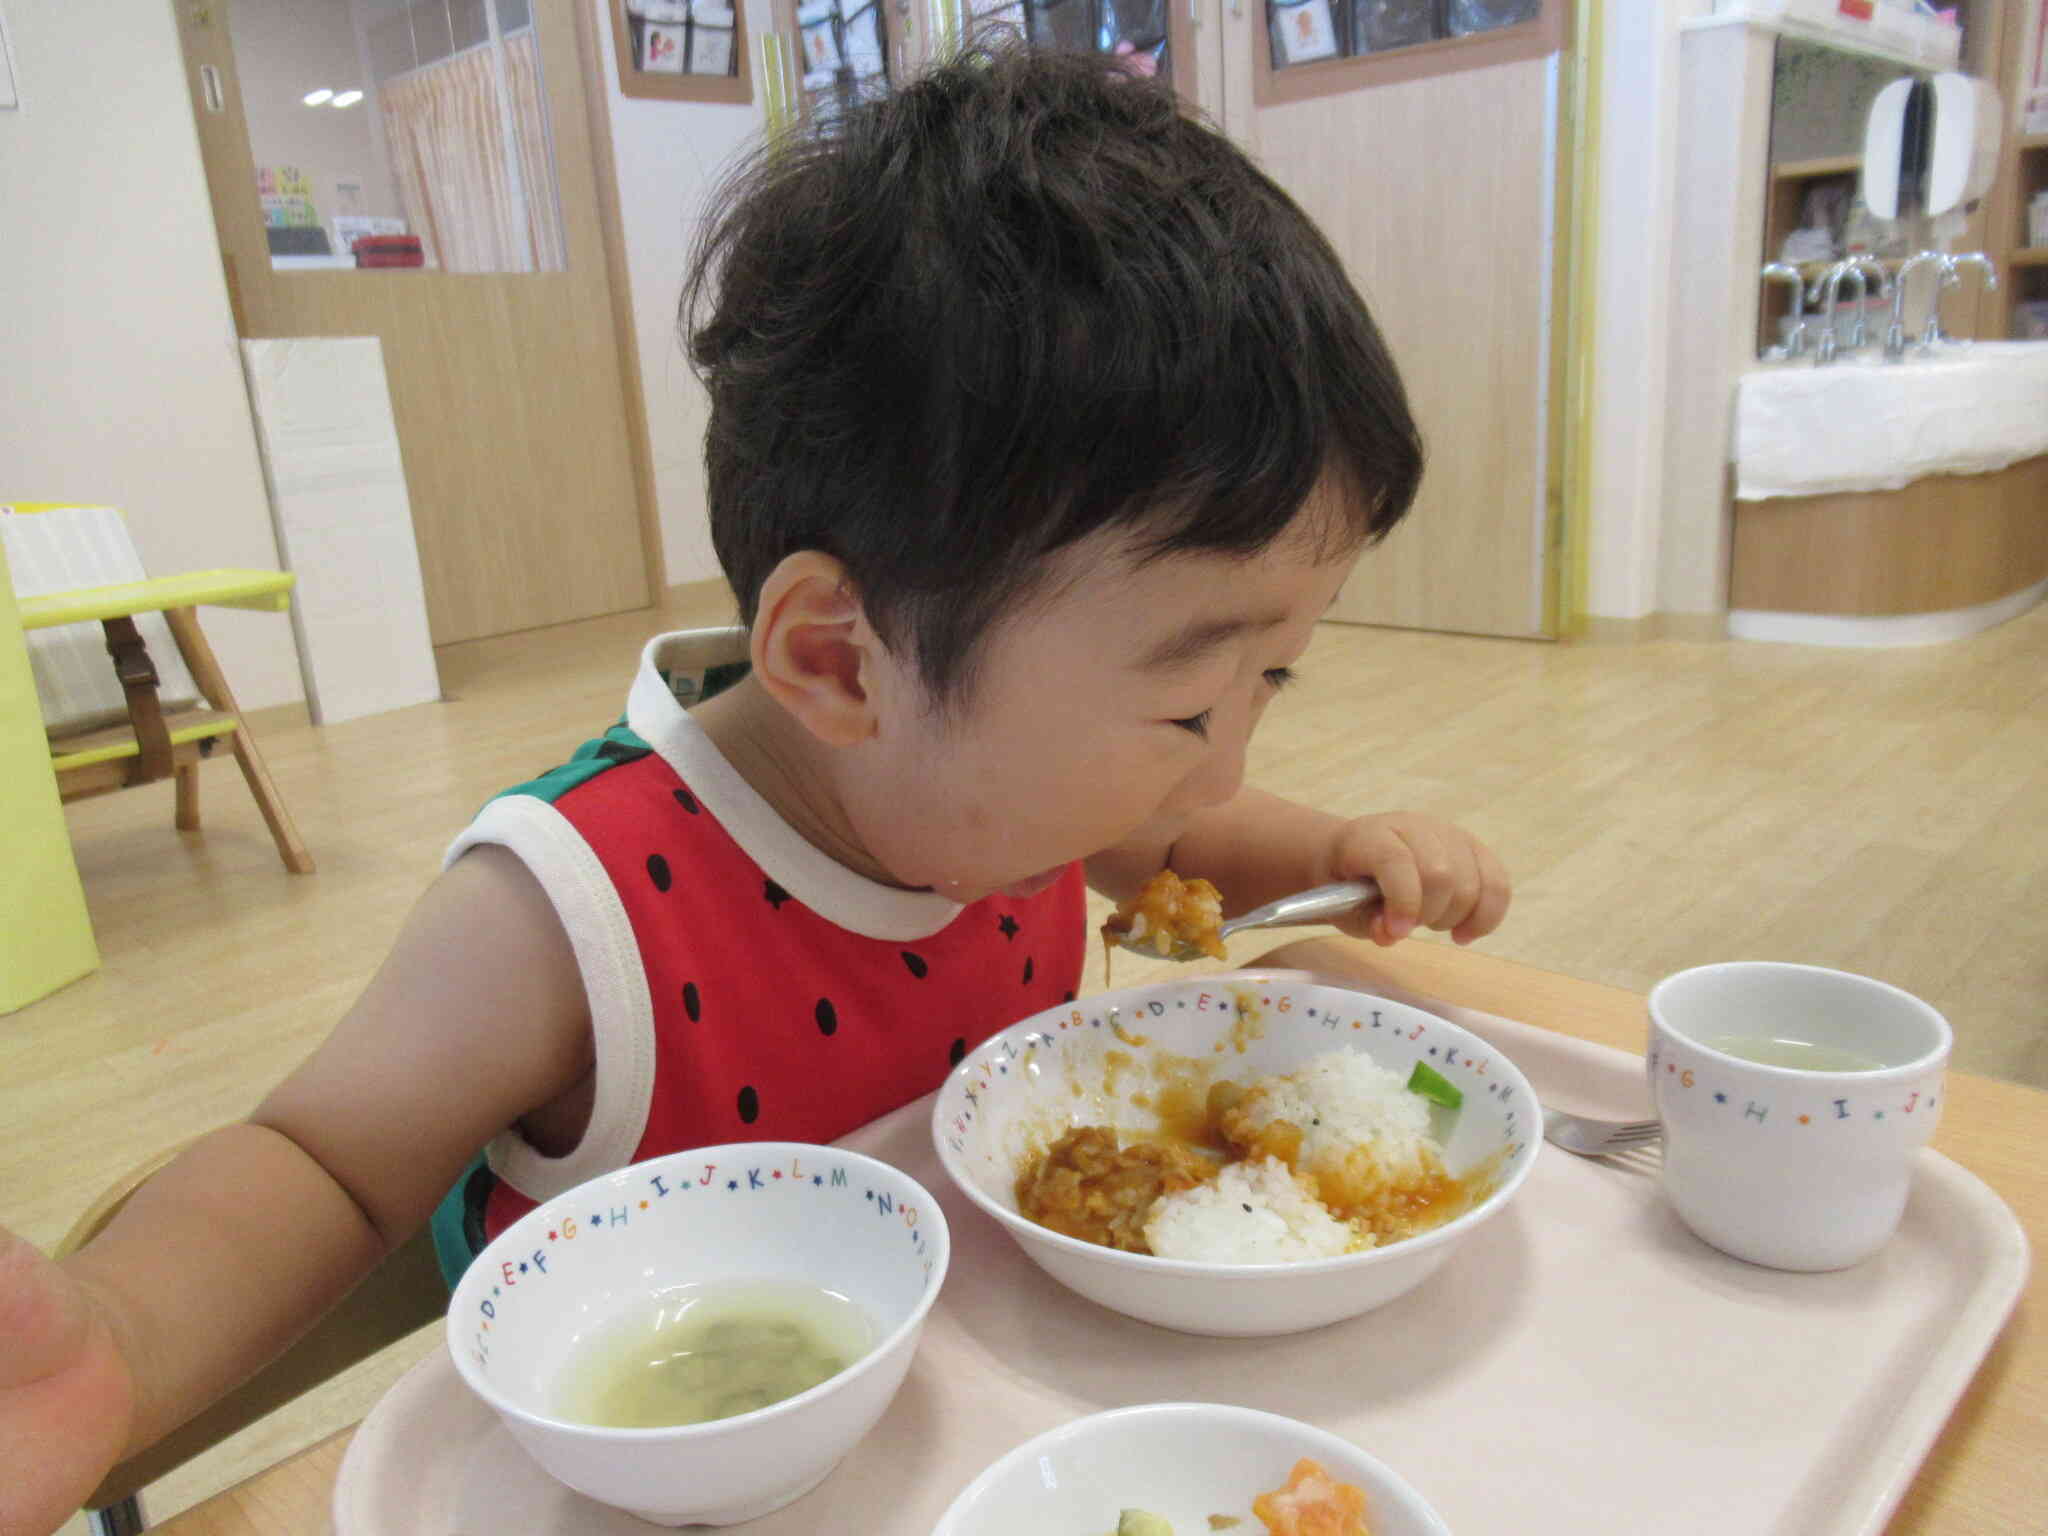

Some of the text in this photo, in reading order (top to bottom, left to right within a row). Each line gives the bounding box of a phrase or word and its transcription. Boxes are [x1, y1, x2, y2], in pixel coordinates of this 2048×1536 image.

[1148, 1001, 1164, 1016] D
[1198, 992, 1214, 1011] E
[1321, 1012, 1340, 1030] H
[1371, 1010, 1382, 1028] I
[1407, 1024, 1425, 1041] J
[1744, 1101, 1768, 1124] H
[1832, 1099, 1851, 1119] I
[1904, 1092, 1920, 1113] J
[480, 1300, 495, 1319] D
[502, 1262, 516, 1285] E
[533, 1249, 547, 1273] F
[562, 1217, 577, 1240] G
[610, 1205, 627, 1228] H
[650, 1176, 669, 1197] I
[700, 1165, 716, 1185] J
[748, 1168, 765, 1189] K
[793, 1158, 805, 1179] L
[831, 1168, 848, 1187] M
[878, 1192, 892, 1216] N
